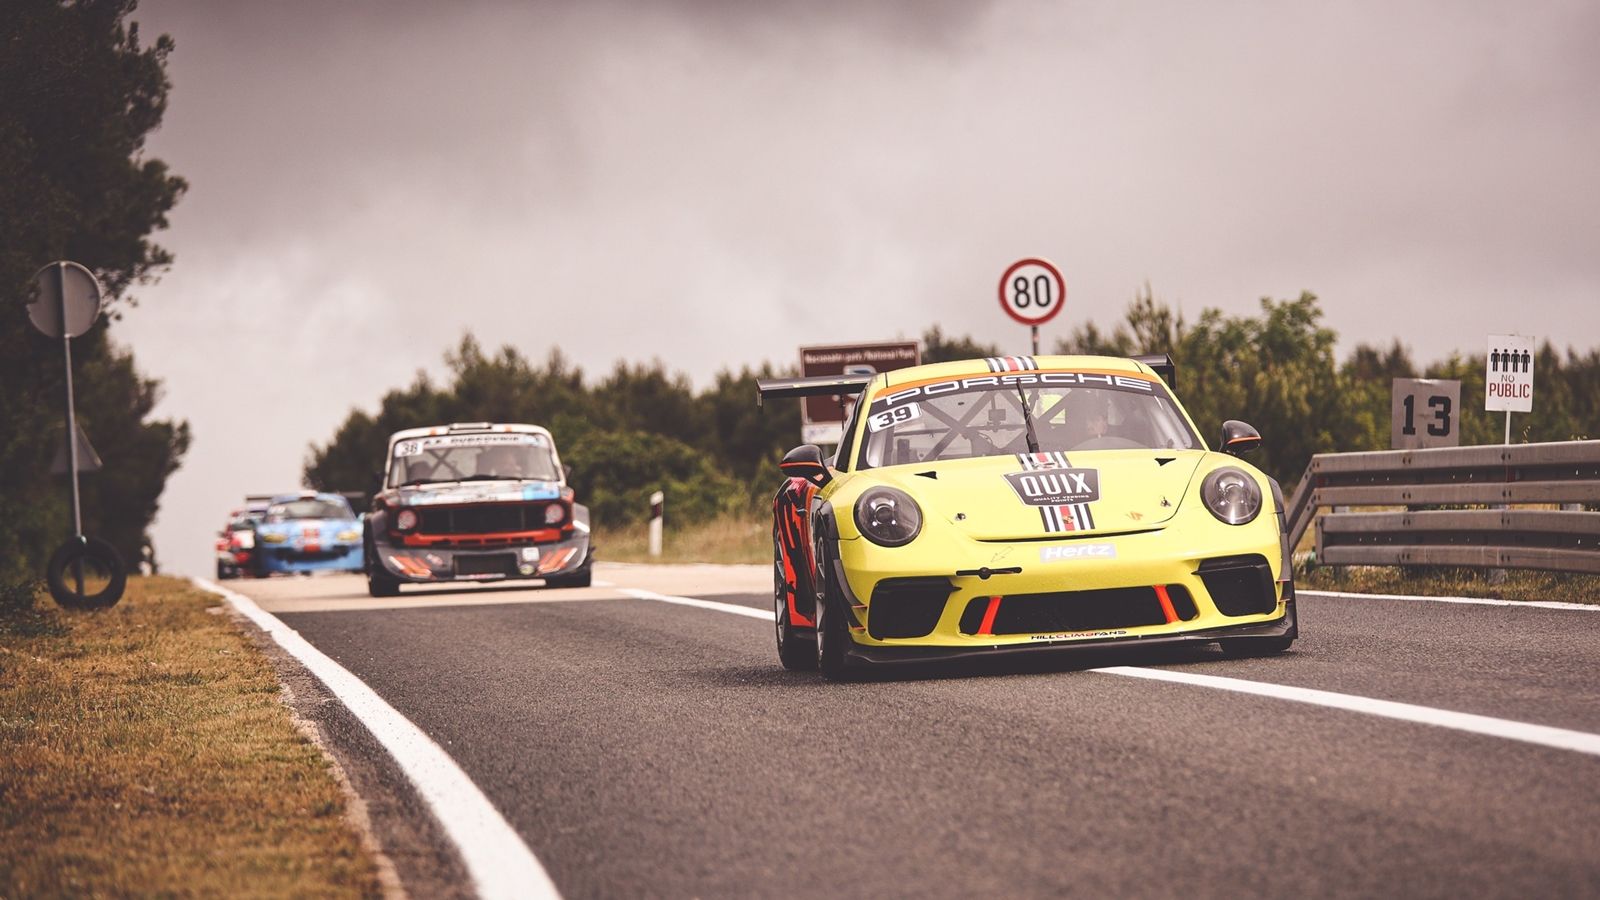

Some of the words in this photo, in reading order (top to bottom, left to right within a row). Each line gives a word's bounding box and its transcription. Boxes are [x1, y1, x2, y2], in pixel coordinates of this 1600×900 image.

[1014, 275, 1051, 309] 80
[886, 373, 1153, 406] PORSCHE
[1501, 374, 1515, 383] NO
[1489, 383, 1530, 398] PUBLIC
[877, 406, 912, 428] 39
[1402, 394, 1451, 437] 13
[1019, 473, 1093, 497] QUIX
[1044, 545, 1111, 560] Hertz
